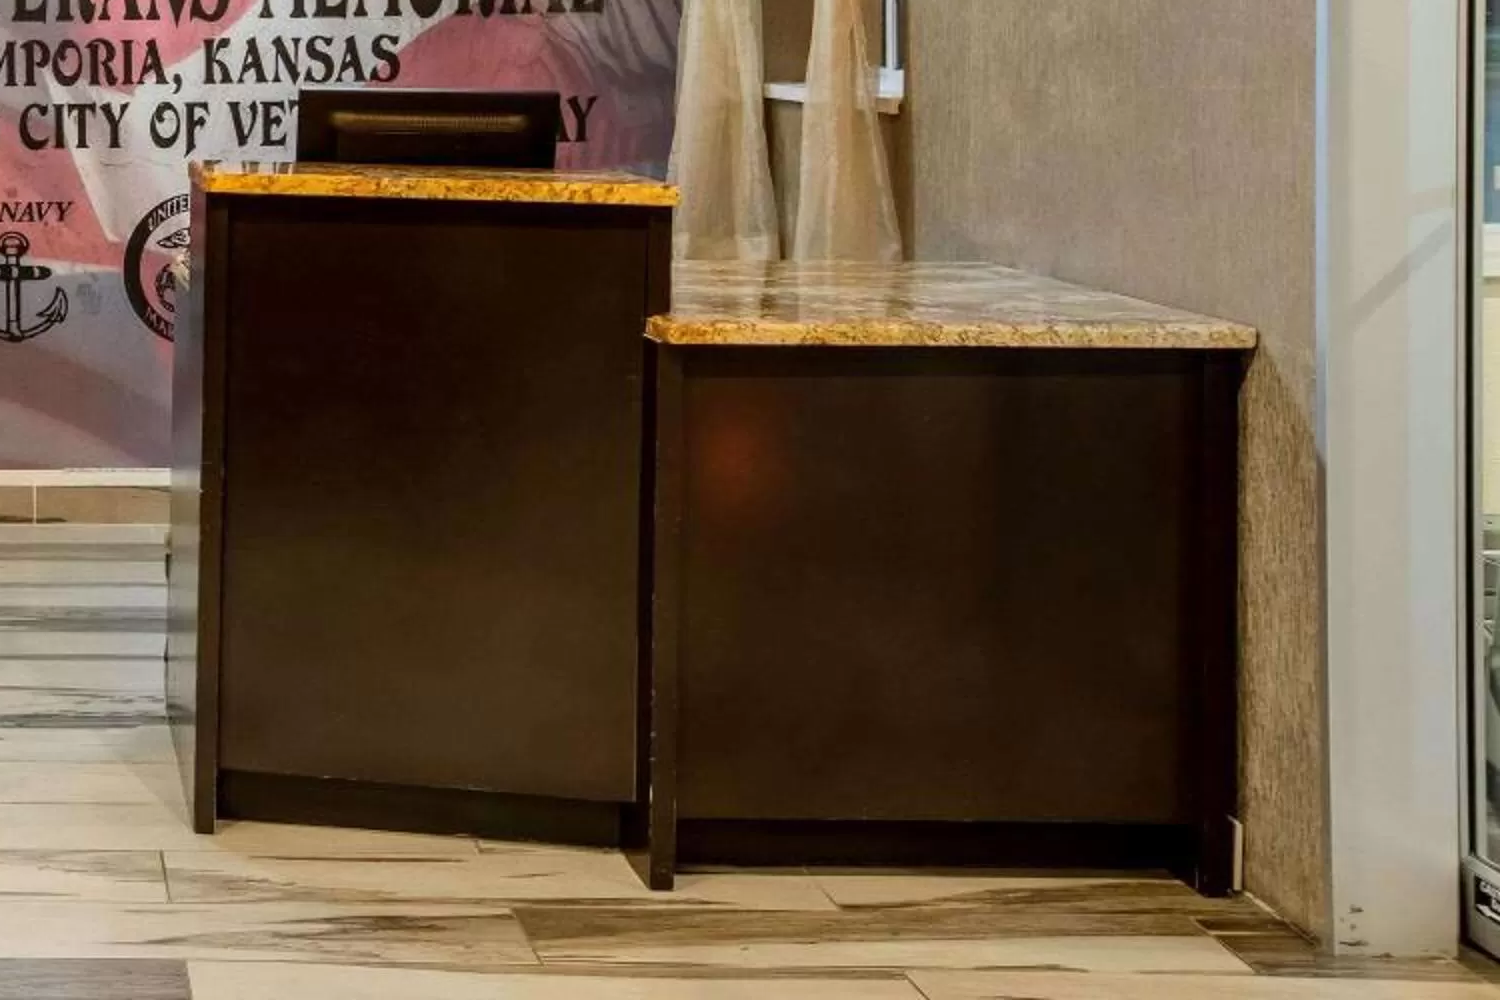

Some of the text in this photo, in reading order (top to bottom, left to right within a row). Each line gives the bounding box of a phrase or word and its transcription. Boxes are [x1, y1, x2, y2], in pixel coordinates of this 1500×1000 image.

[203, 34, 400, 85] KANSAS
[19, 101, 128, 151] CITY
[149, 101, 211, 158] OF
[147, 194, 190, 232] UNITE
